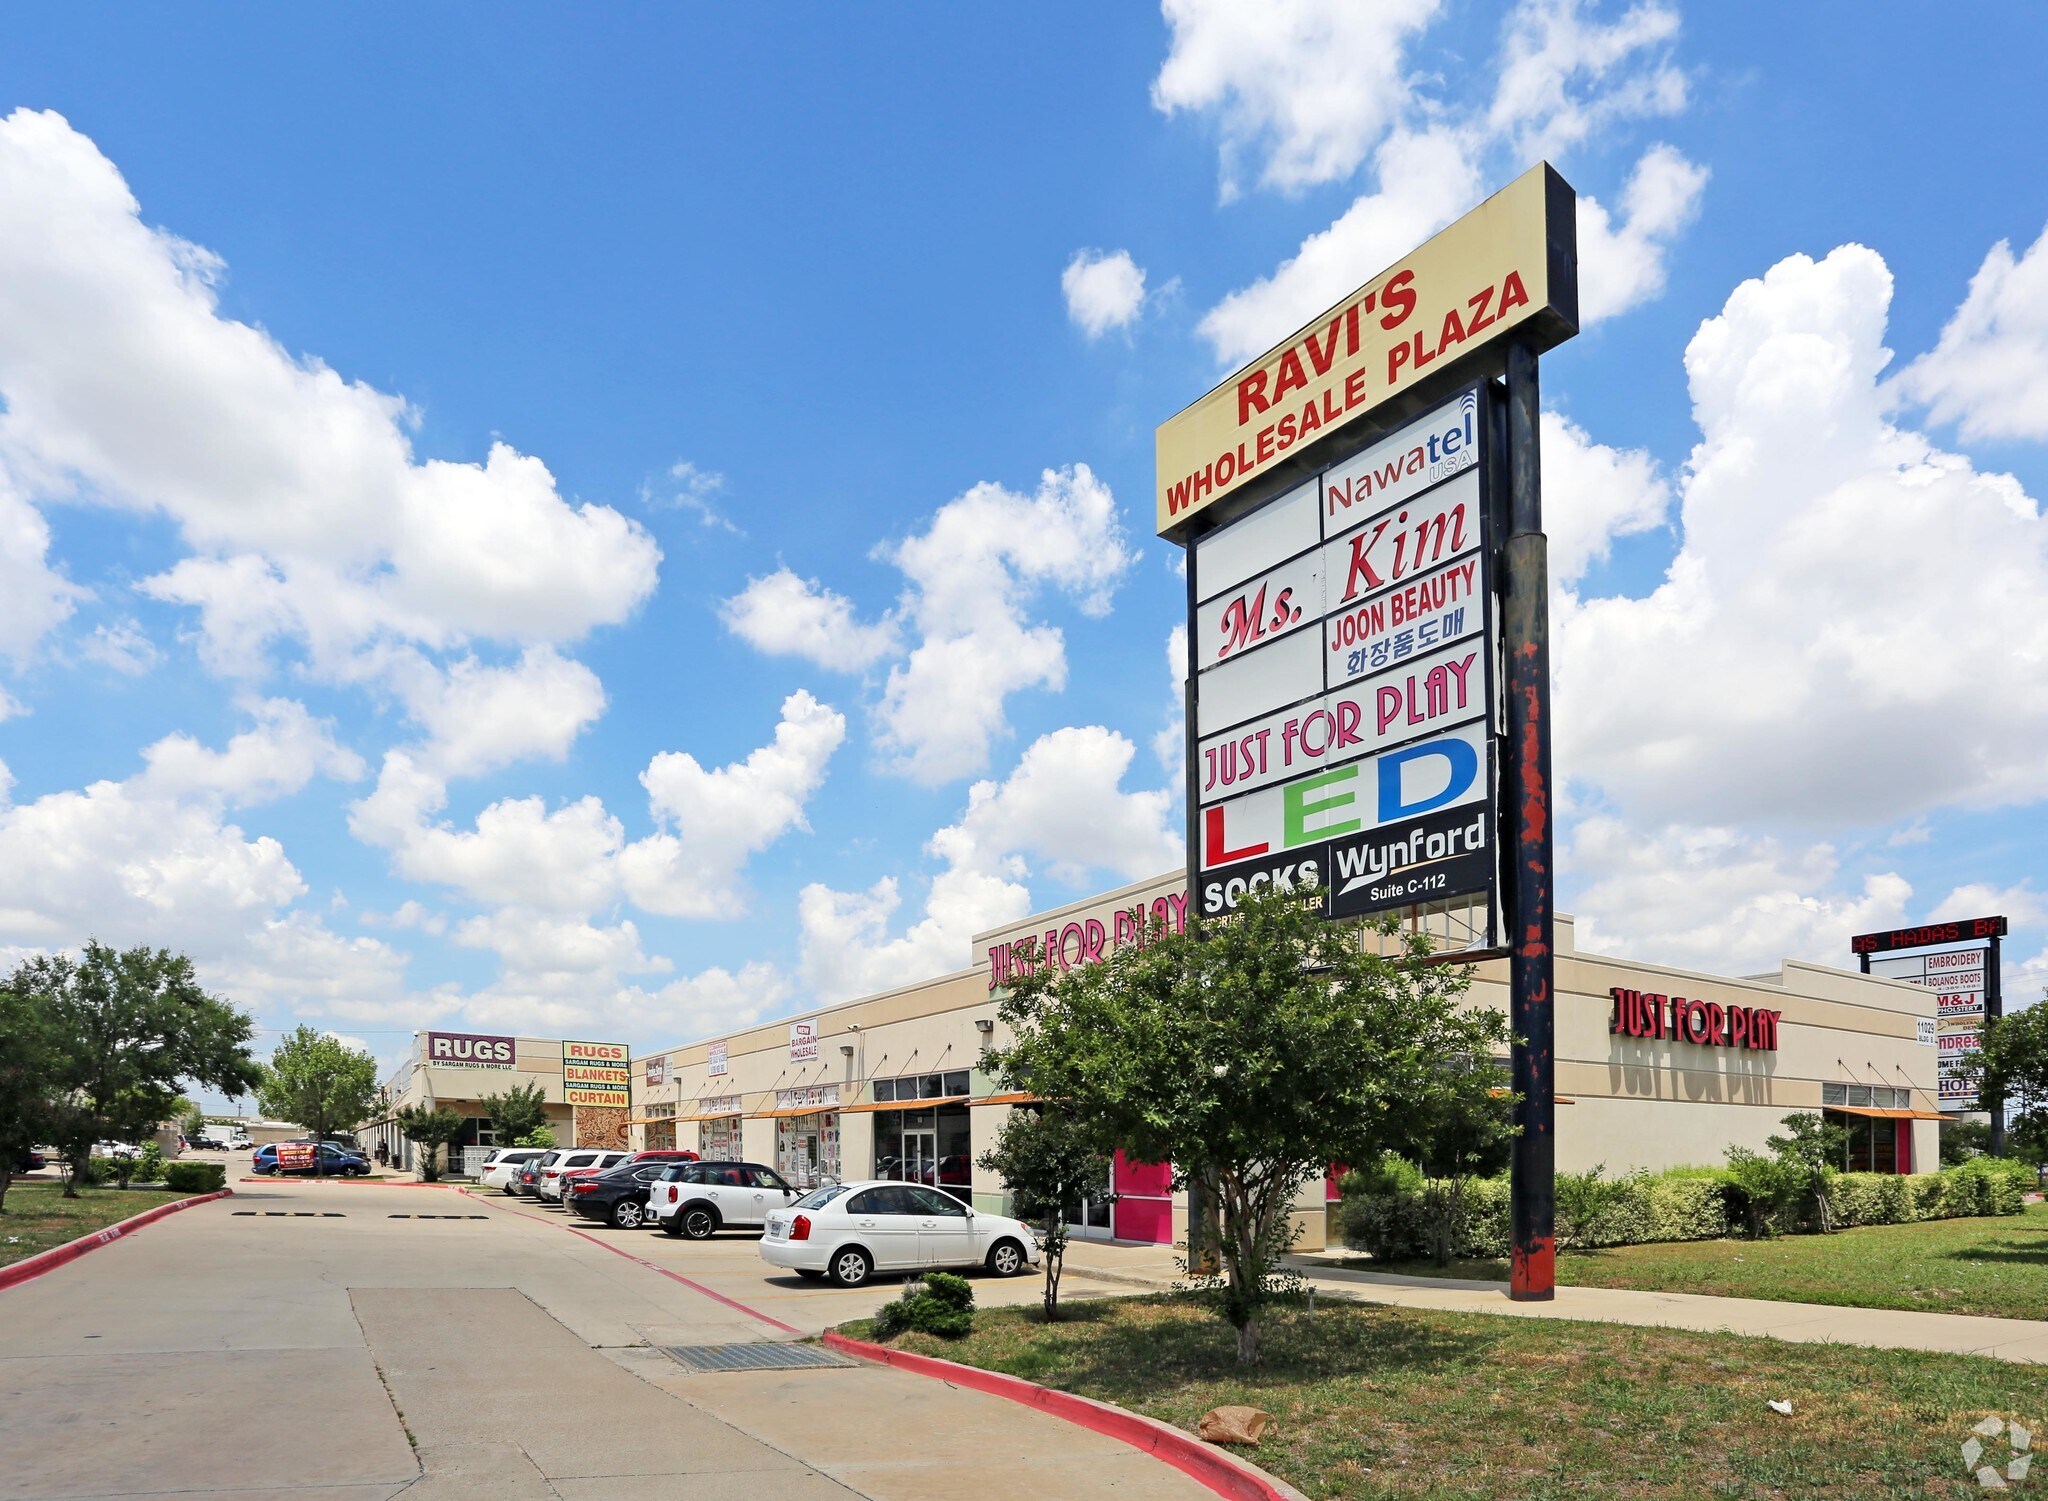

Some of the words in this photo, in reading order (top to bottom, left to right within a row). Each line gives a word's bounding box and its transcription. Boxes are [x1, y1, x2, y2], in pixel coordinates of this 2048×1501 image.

[1238, 269, 1418, 427] RAVI'S
[1167, 367, 1367, 517] WHOLESALE
[1389, 270, 1530, 386] PLAZA
[1328, 412, 1472, 516] Nawatel
[1429, 450, 1473, 483] USA
[1217, 581, 1302, 658] Ms.
[1341, 502, 1468, 603] Kim
[1331, 601, 1385, 652] JOON
[1390, 559, 1477, 627] BEAUTY
[1347, 606, 1465, 677] 화장품도매
[1205, 728, 1271, 793] JUST
[1282, 698, 1362, 766] FOR
[1376, 652, 1478, 736] PLAY
[1206, 737, 1479, 867] LED
[1336, 813, 1486, 894] Wynford
[1370, 881, 1405, 901] Suite
[1407, 873, 1447, 895] C-112
[1045, 918, 1106, 972] FOR
[1890, 923, 1959, 947] HADAS
[1928, 952, 1982, 969] EMBROIDERY
[1928, 975, 1958, 987] BOLANOS
[1960, 973, 1981, 984] BOOTS
[797, 1026, 810, 1035] NEW
[1610, 987, 1667, 1039] JUST
[1671, 997, 1725, 1047] FOR
[1727, 1005, 1781, 1051] PLAY
[1917, 1020, 1934, 1035] 11029
[433, 1037, 511, 1061] RUGS
[570, 1045, 622, 1059] RUGS
[791, 1035, 817, 1048] BARGAIN
[791, 1046, 817, 1059] WHOLESALE
[565, 1082, 589, 1090] SARGAM
[567, 1068, 627, 1082] BLANKETS
[569, 1092, 625, 1104] CURTAIN
